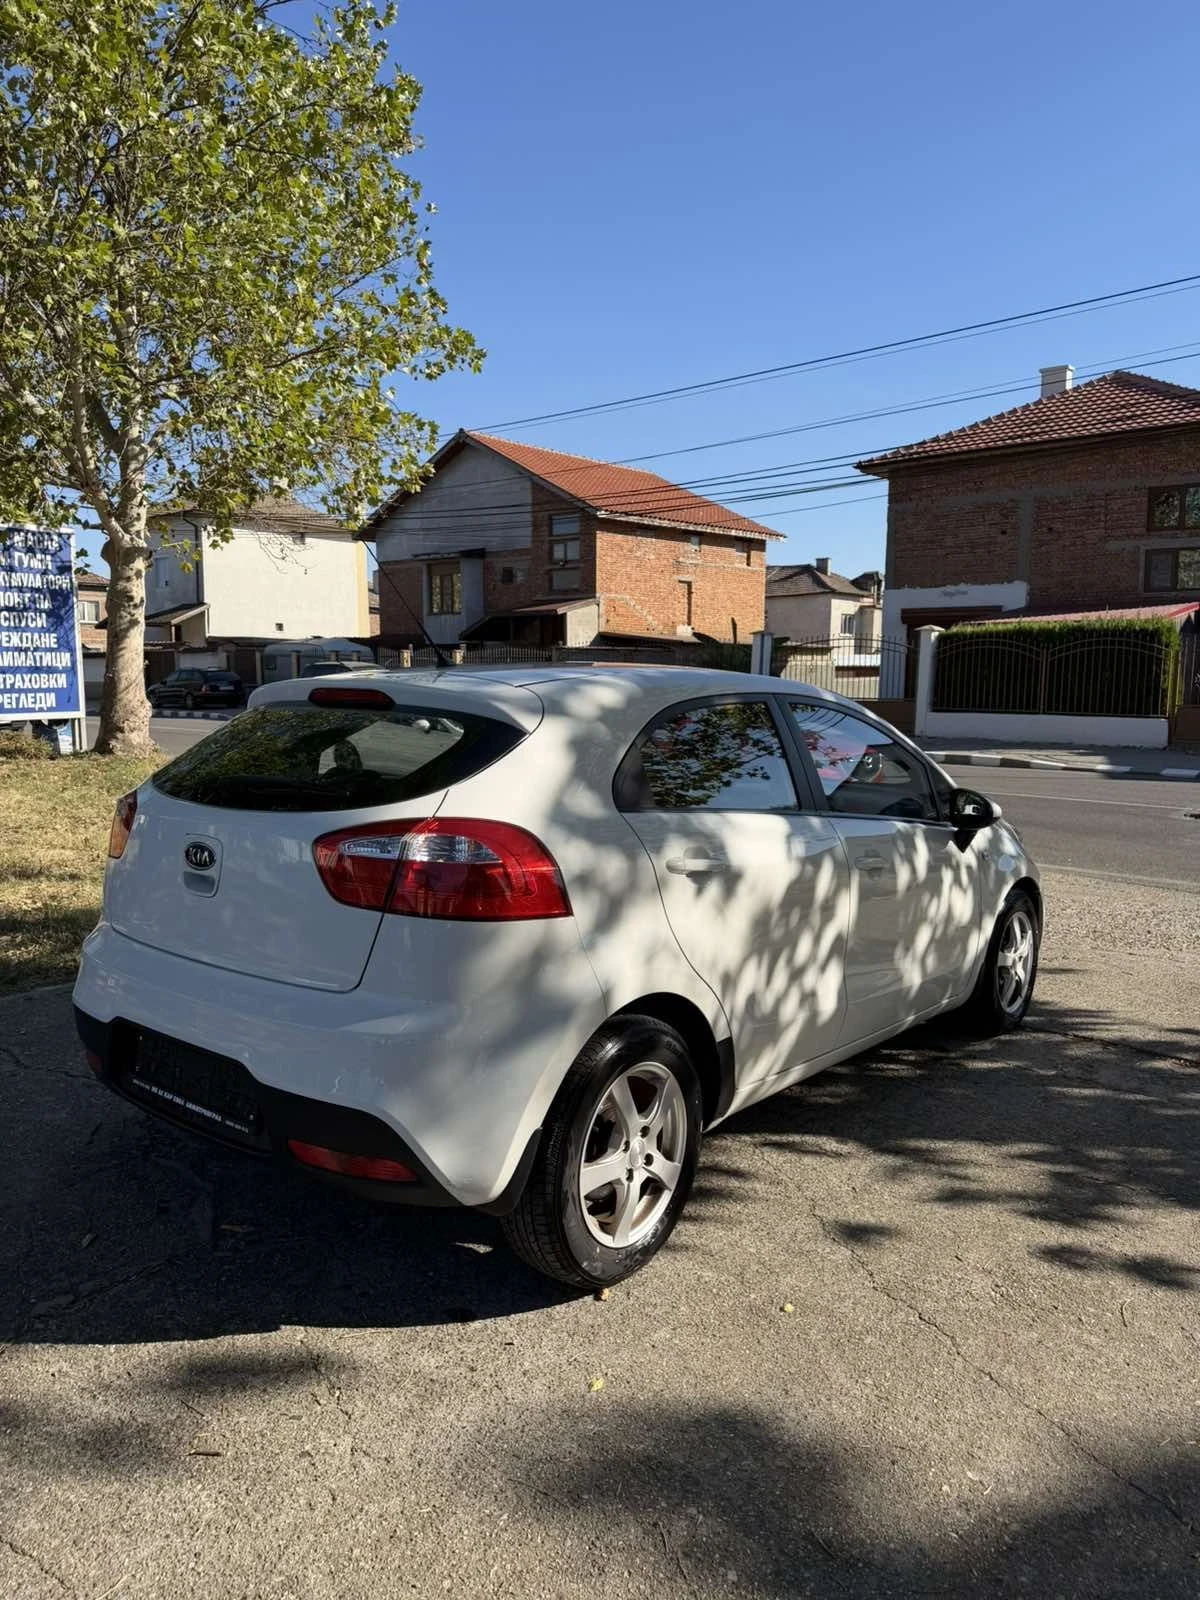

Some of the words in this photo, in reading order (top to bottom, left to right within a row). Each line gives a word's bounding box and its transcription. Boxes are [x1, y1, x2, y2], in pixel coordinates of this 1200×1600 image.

[14, 552, 52, 570] ГУМИ
[34, 593, 53, 609] НА
[0, 610, 47, 628] СПУСИ
[0, 631, 58, 651] ЕЖДАНЕ
[188, 847, 210, 865] KIA
